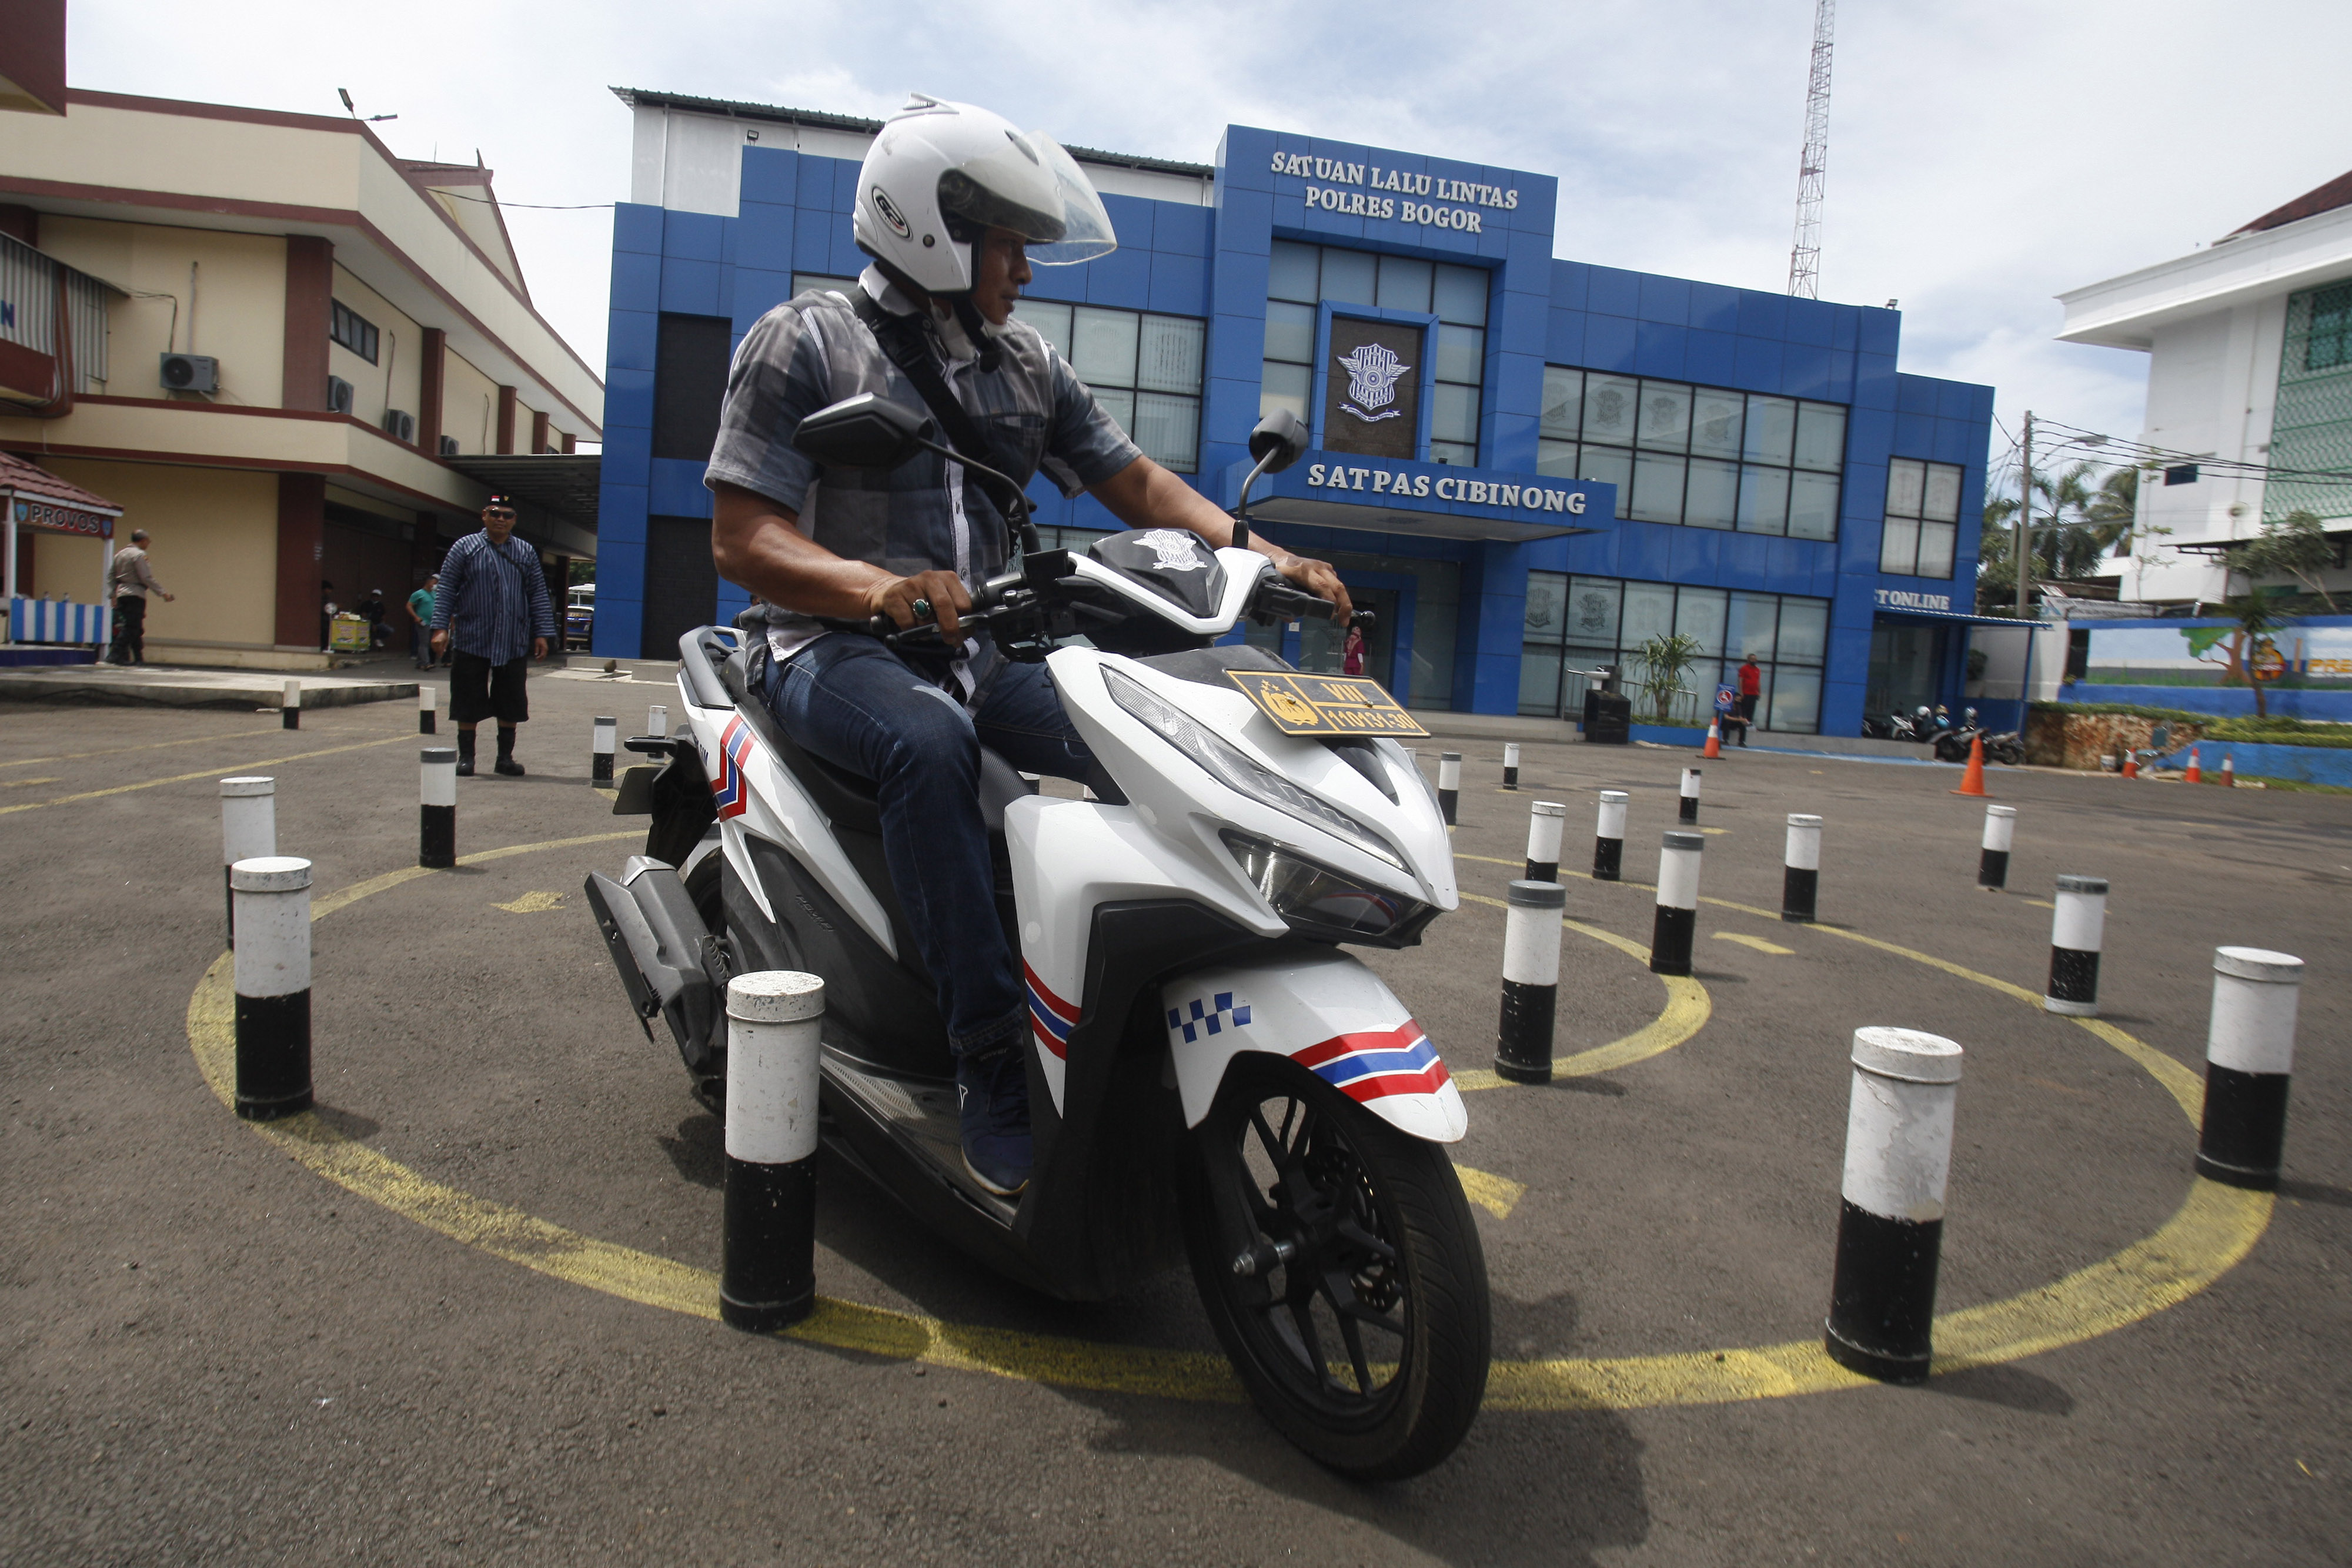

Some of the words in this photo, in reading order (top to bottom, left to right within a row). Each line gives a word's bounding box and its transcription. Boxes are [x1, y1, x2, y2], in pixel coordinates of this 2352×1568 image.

[1271, 152, 1365, 185] SATUAN
[1371, 167, 1431, 196] LALU
[1436, 179, 1518, 209] LINTAS
[1305, 186, 1394, 219] POLRES
[1400, 201, 1482, 233] BOGOR
[1308, 464, 1429, 497] SATPAS
[1435, 477, 1586, 514] CIBINONG
[31, 504, 99, 533] PROVOS
[1320, 683, 1368, 701] VIII
[1328, 710, 1416, 729] 110131-30
